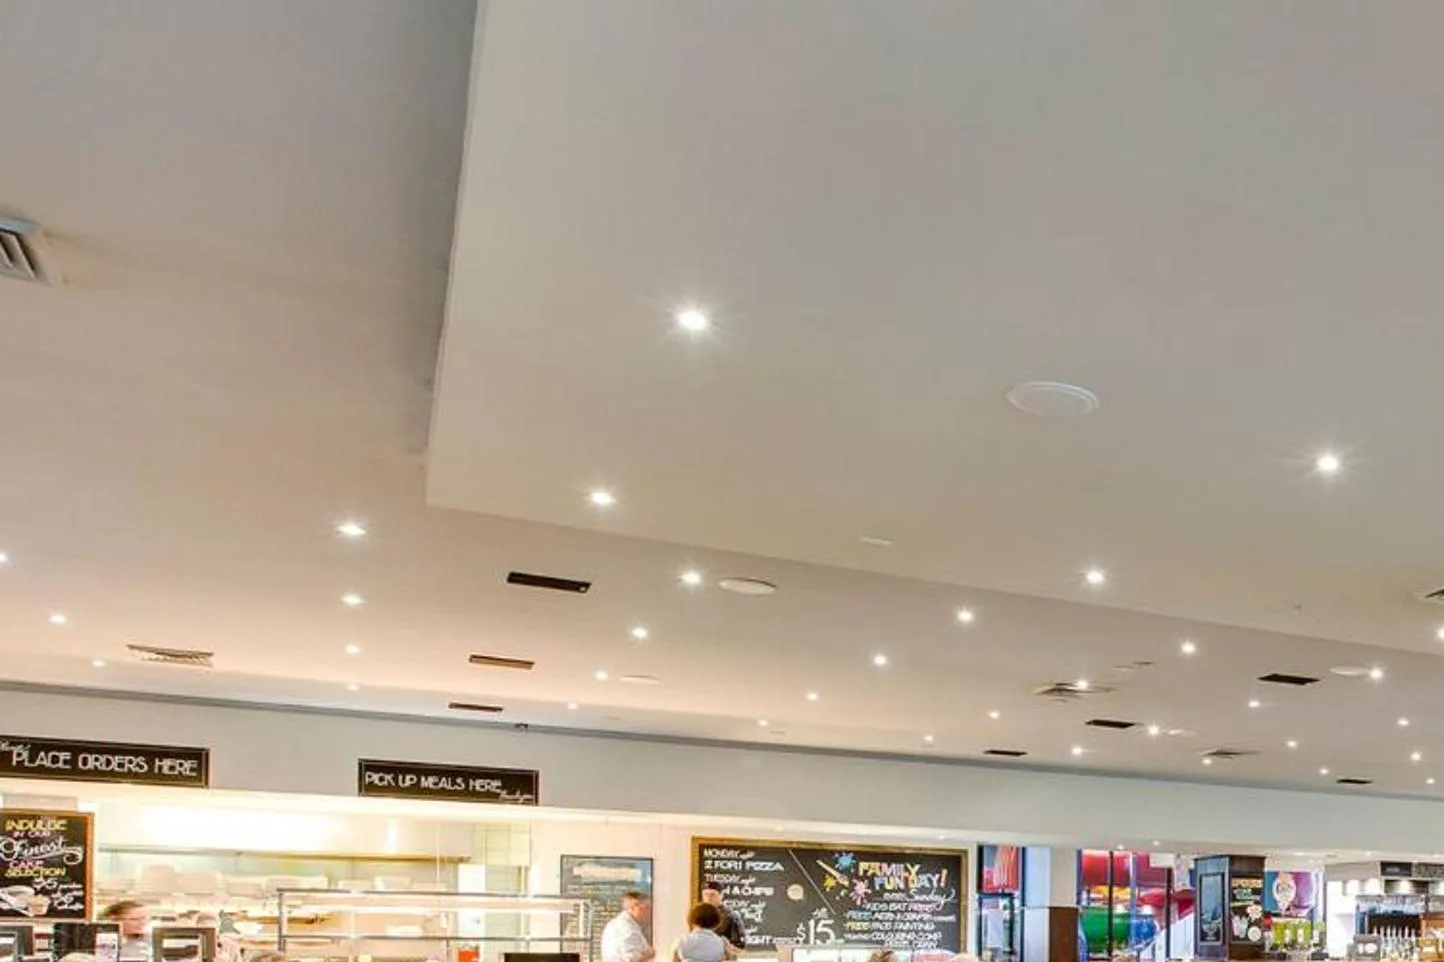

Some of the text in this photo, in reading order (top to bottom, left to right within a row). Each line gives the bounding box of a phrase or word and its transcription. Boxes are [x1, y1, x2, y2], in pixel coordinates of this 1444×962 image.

[12, 749, 198, 776] PLACE ORDERS HERE
[365, 771, 502, 793] PICK UP MEALS HERE
[5, 819, 68, 831] INDULGE
[704, 848, 739, 858] MONDAY
[745, 861, 785, 871] PIZZA
[858, 862, 921, 883] FAMILY
[873, 876, 905, 890] FUN
